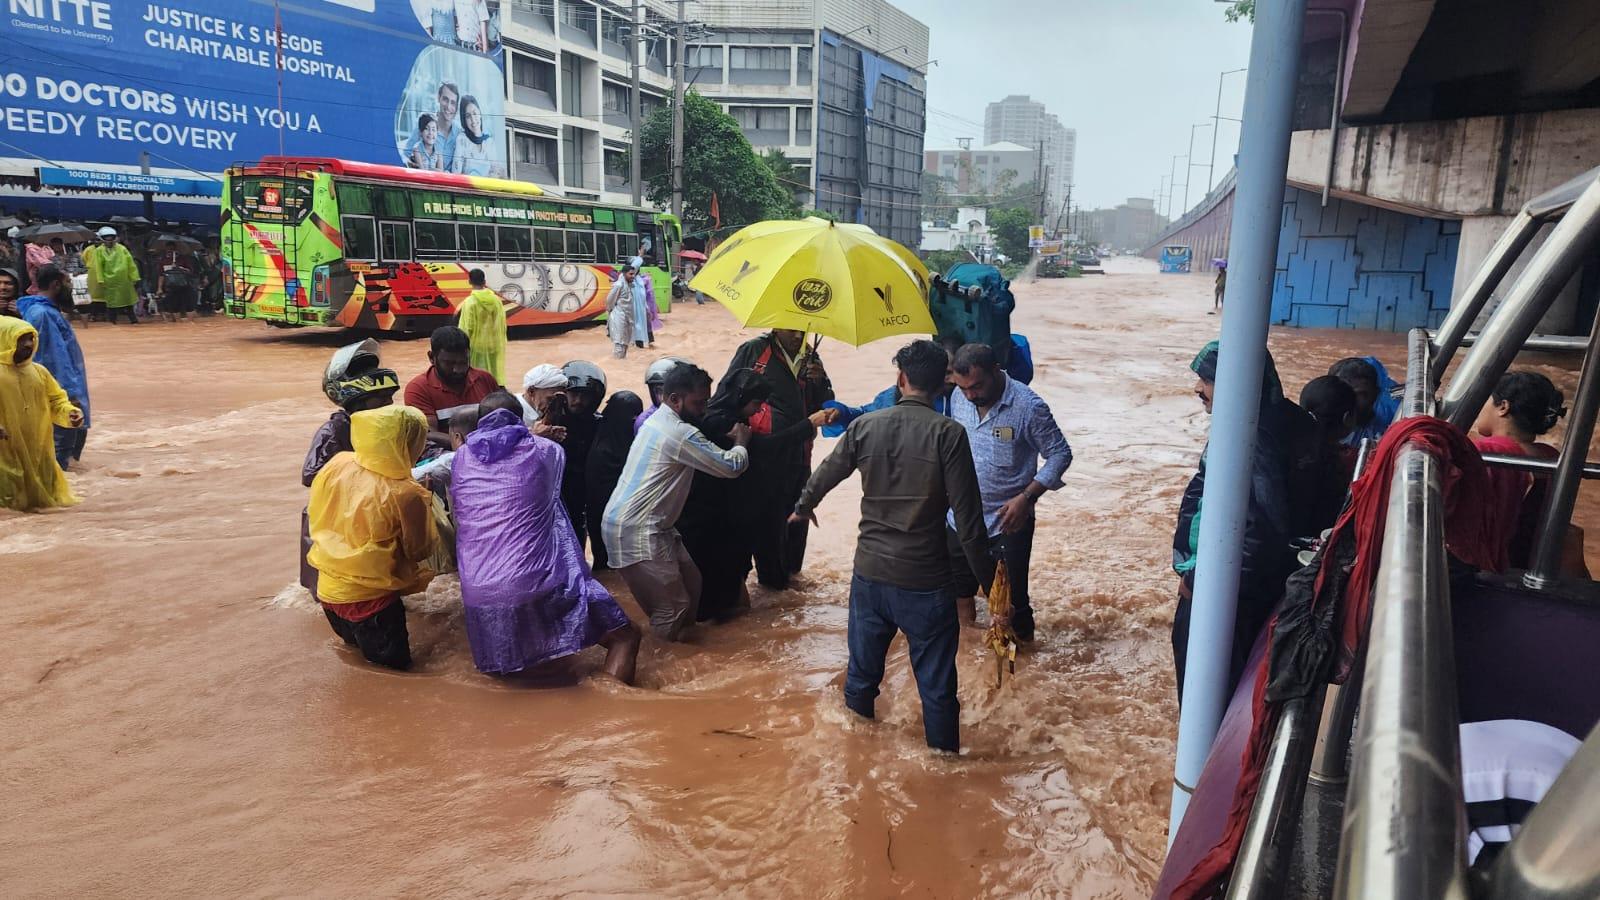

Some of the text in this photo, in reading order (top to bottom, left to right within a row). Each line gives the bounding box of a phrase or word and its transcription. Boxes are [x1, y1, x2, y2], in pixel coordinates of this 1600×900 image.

[11, 18, 49, 31] (Deemed
[61, 27, 72, 35] be
[73, 29, 114, 43] University)
[143, 4, 323, 56] JUSTICE K S HEGDE
[144, 29, 356, 83] CHARITABLE HOSPITAL
[35, 76, 177, 115] DOCTORS
[183, 96, 248, 125] WISH
[253, 106, 300, 131] YOU
[307, 114, 322, 133] A
[0, 107, 237, 151] EEDY RECOVERY
[68, 170, 89, 178] 1000
[90, 172, 112, 180] BEDS
[127, 175, 175, 185] SPECIALTIES
[86, 180, 160, 191] NABH ACCREDITED
[424, 202, 432, 213] A
[433, 203, 452, 214] BUS
[452, 204, 472, 216] RIDE
[483, 206, 502, 218] LIKE
[503, 208, 526, 220] BEING
[527, 209, 535, 220] IN
[535, 210, 568, 223] ANOTHER
[569, 213, 593, 224] WORLD
[714, 279, 741, 301] YAFCO
[879, 314, 910, 327] YAFCO
